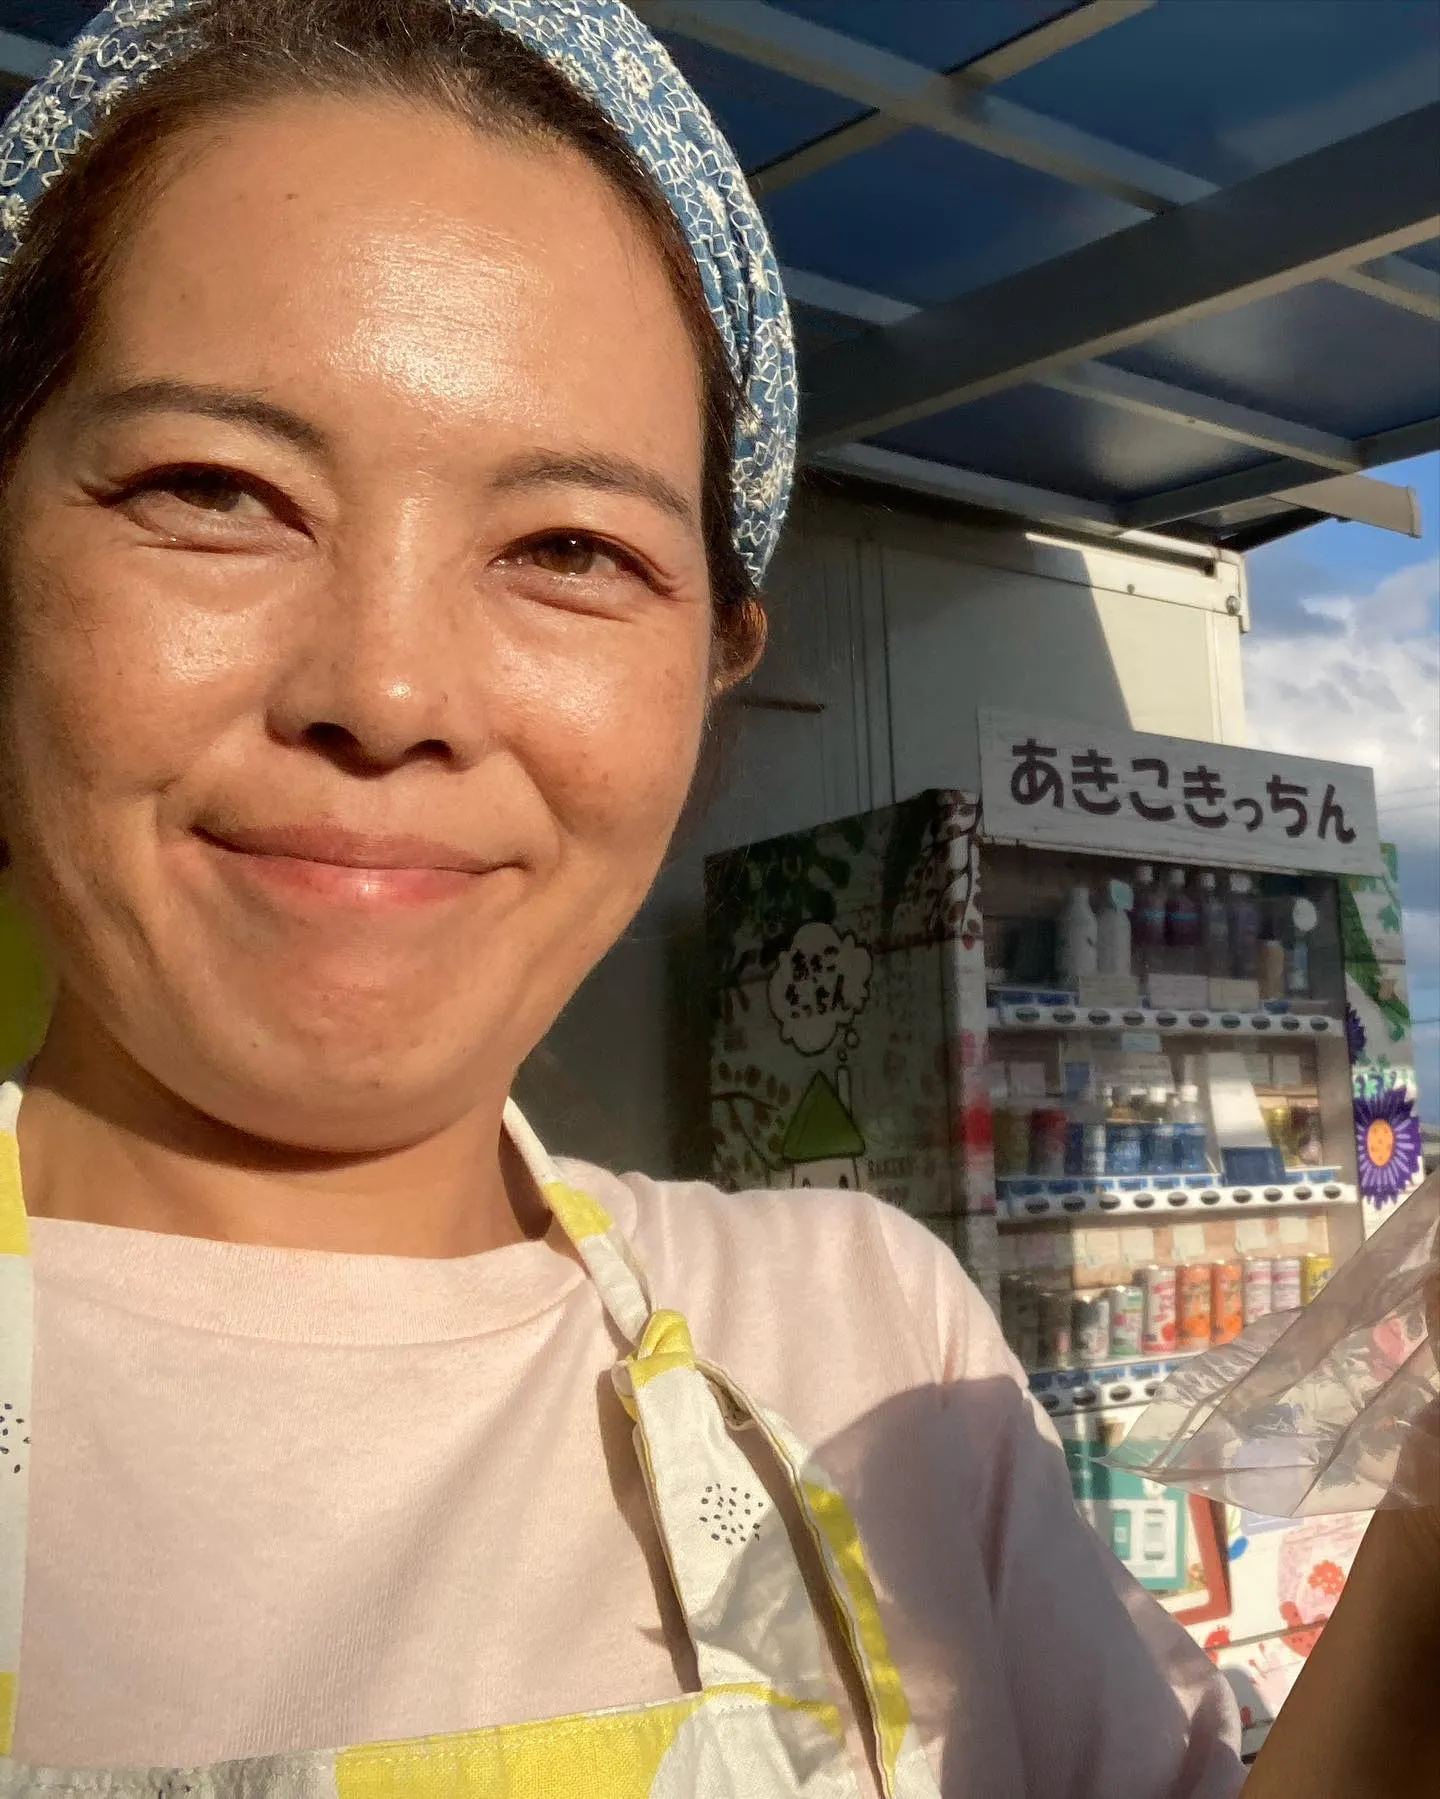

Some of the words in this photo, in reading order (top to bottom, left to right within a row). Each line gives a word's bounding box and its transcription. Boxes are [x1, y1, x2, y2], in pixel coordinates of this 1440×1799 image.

[1011, 738, 1355, 844] あきこきっちん
